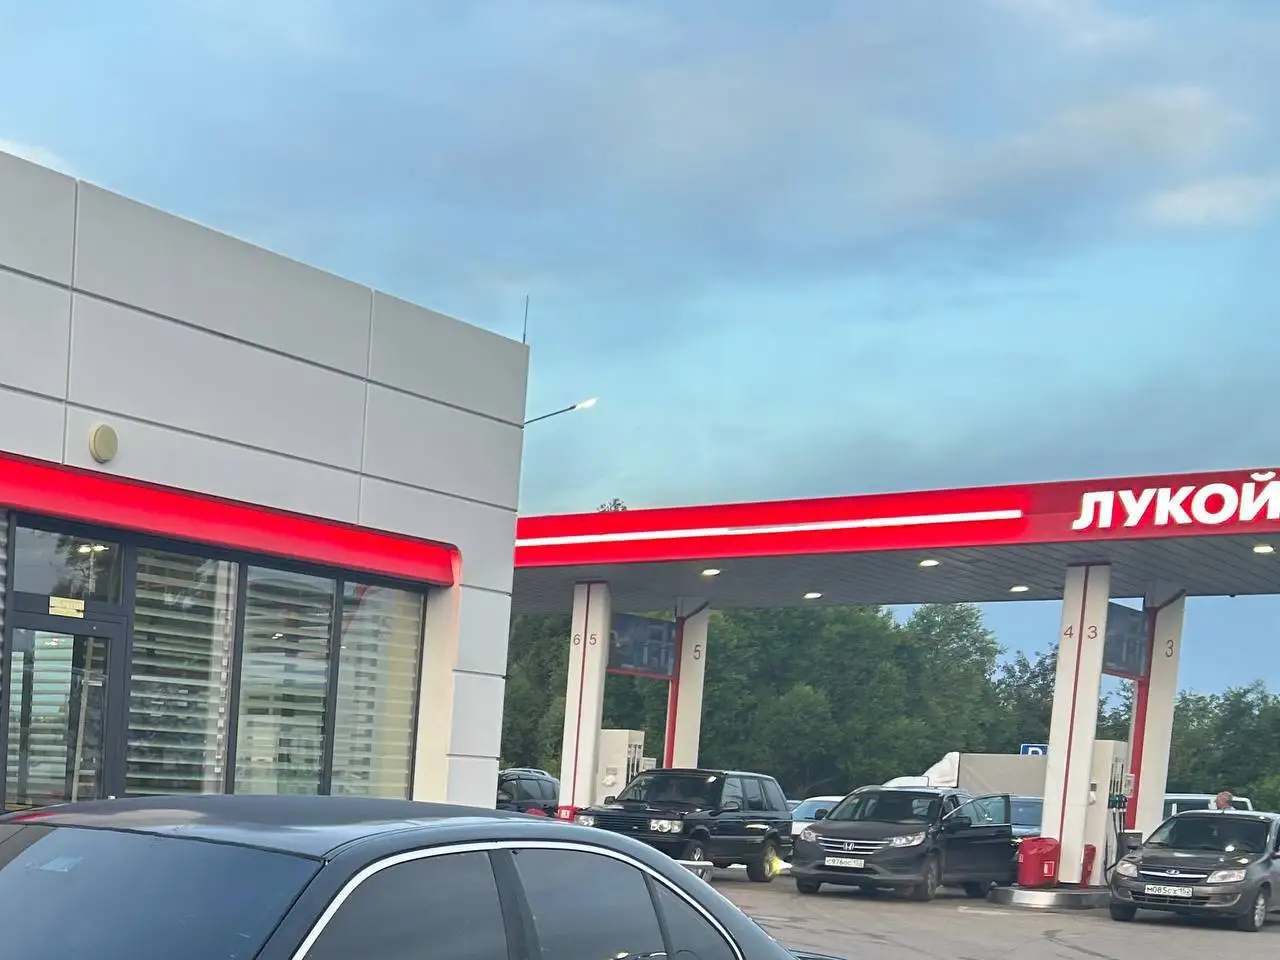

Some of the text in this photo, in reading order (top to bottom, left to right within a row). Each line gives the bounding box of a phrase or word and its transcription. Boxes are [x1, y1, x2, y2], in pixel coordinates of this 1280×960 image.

[1072, 472, 1280, 529] ЛУКОЙ
[573, 633, 597, 645] 6 5
[1063, 625, 1098, 640] 4 3
[693, 644, 701, 659] 5
[1165, 639, 1174, 658] 3
